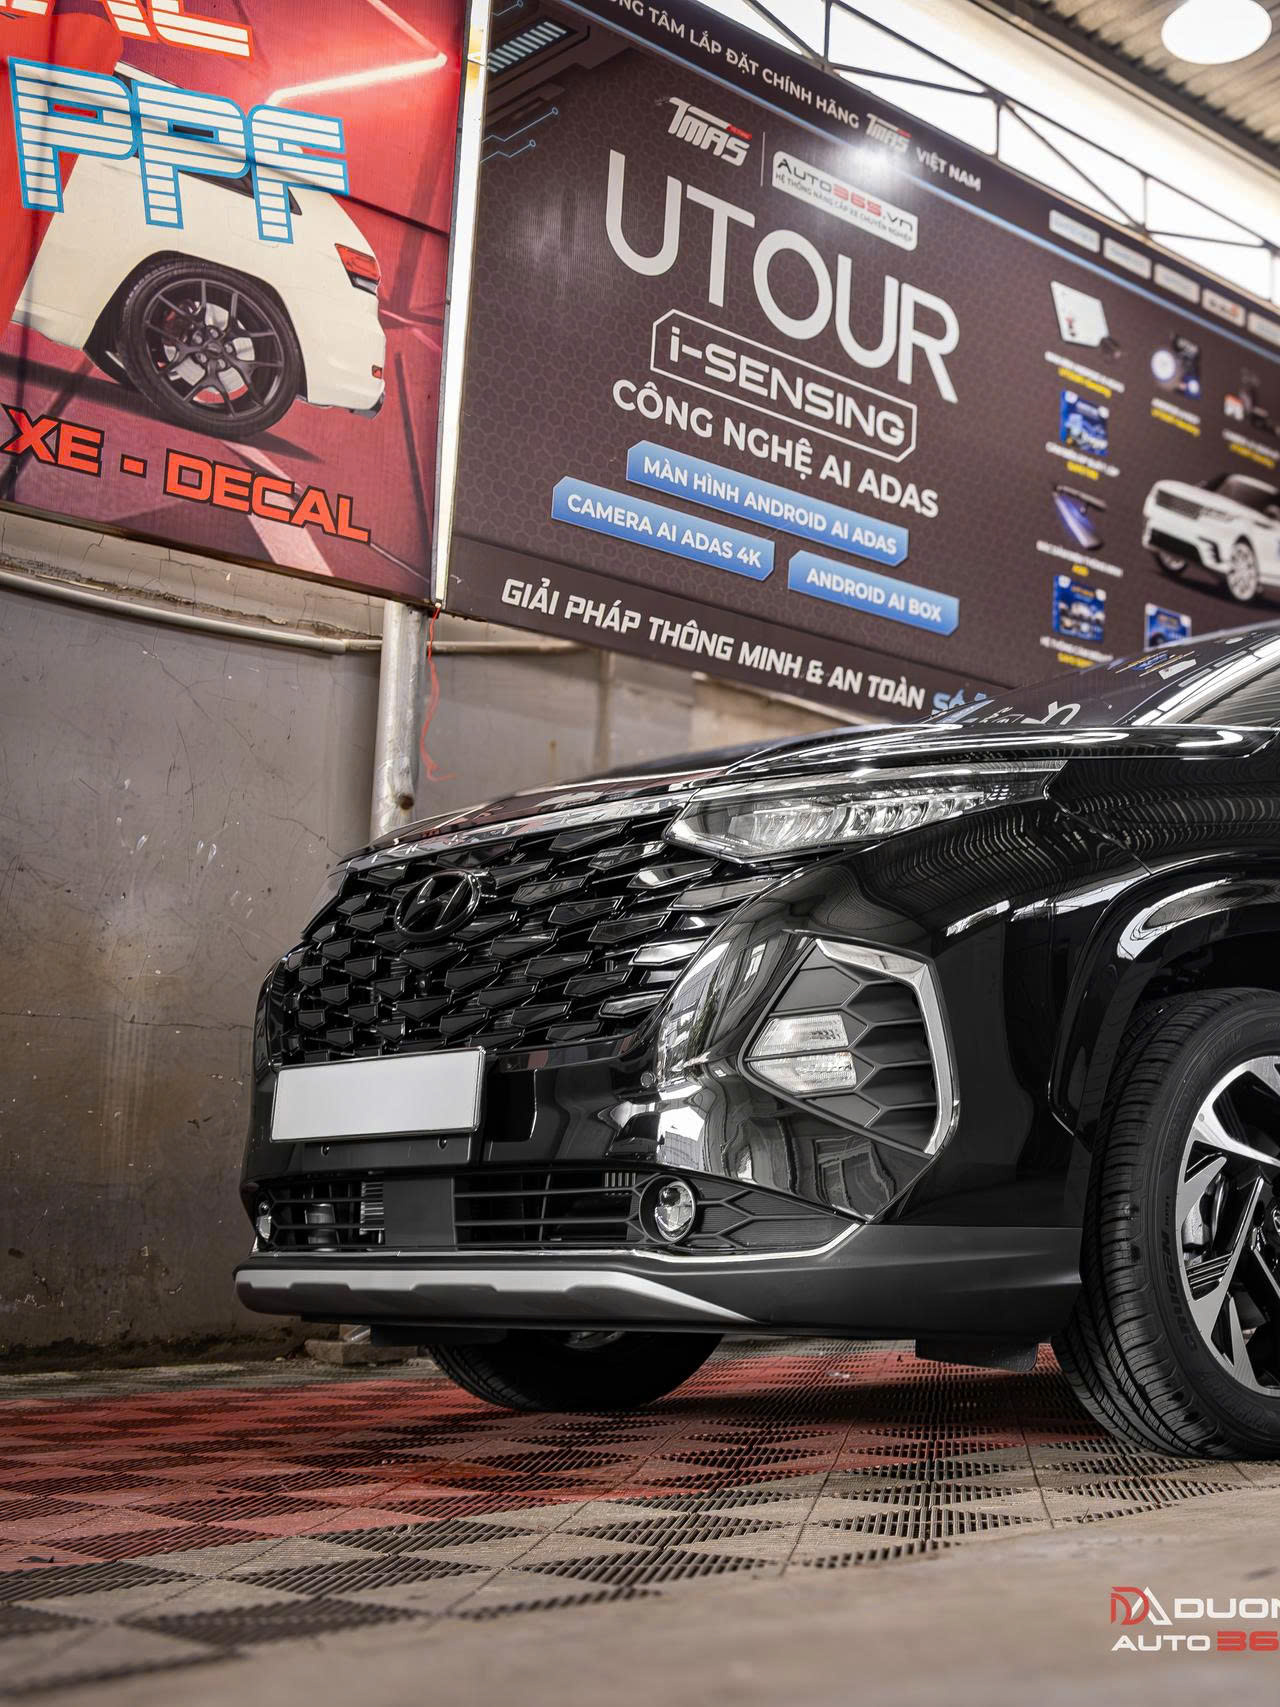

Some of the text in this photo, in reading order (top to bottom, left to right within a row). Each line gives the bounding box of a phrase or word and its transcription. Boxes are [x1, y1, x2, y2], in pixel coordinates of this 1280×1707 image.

[8, 56, 349, 244] PPF
[648, 6, 686, 39] TÂM
[689, 30, 722, 56] LẮP
[725, 48, 759, 75] ĐẶT
[762, 67, 812, 105] CHÍNH
[816, 95, 860, 129] HÃNG
[916, 146, 948, 173] VIỆT
[949, 163, 982, 192] NAM
[667, 96, 752, 167] TMAS
[605, 148, 960, 404] UTOUR
[1, 405, 104, 477] XE
[163, 447, 371, 544] DECAL
[612, 379, 939, 519] CÔNG NGHỆ AI ADAS
[643, 455, 898, 556] MÀN HÌNH ANDROID AI ADAS
[567, 493, 762, 569] CAMERA AI ADAS 4K
[806, 567, 943, 623] ANDROID AI BOX
[501, 577, 560, 615] GIẢI
[564, 594, 642, 634] PHÁP
[649, 618, 735, 661] THÔNG
[737, 640, 802, 679] MINH
[805, 659, 824, 683] &
[827, 666, 862, 694] AN
[867, 675, 926, 711] TOÀN
